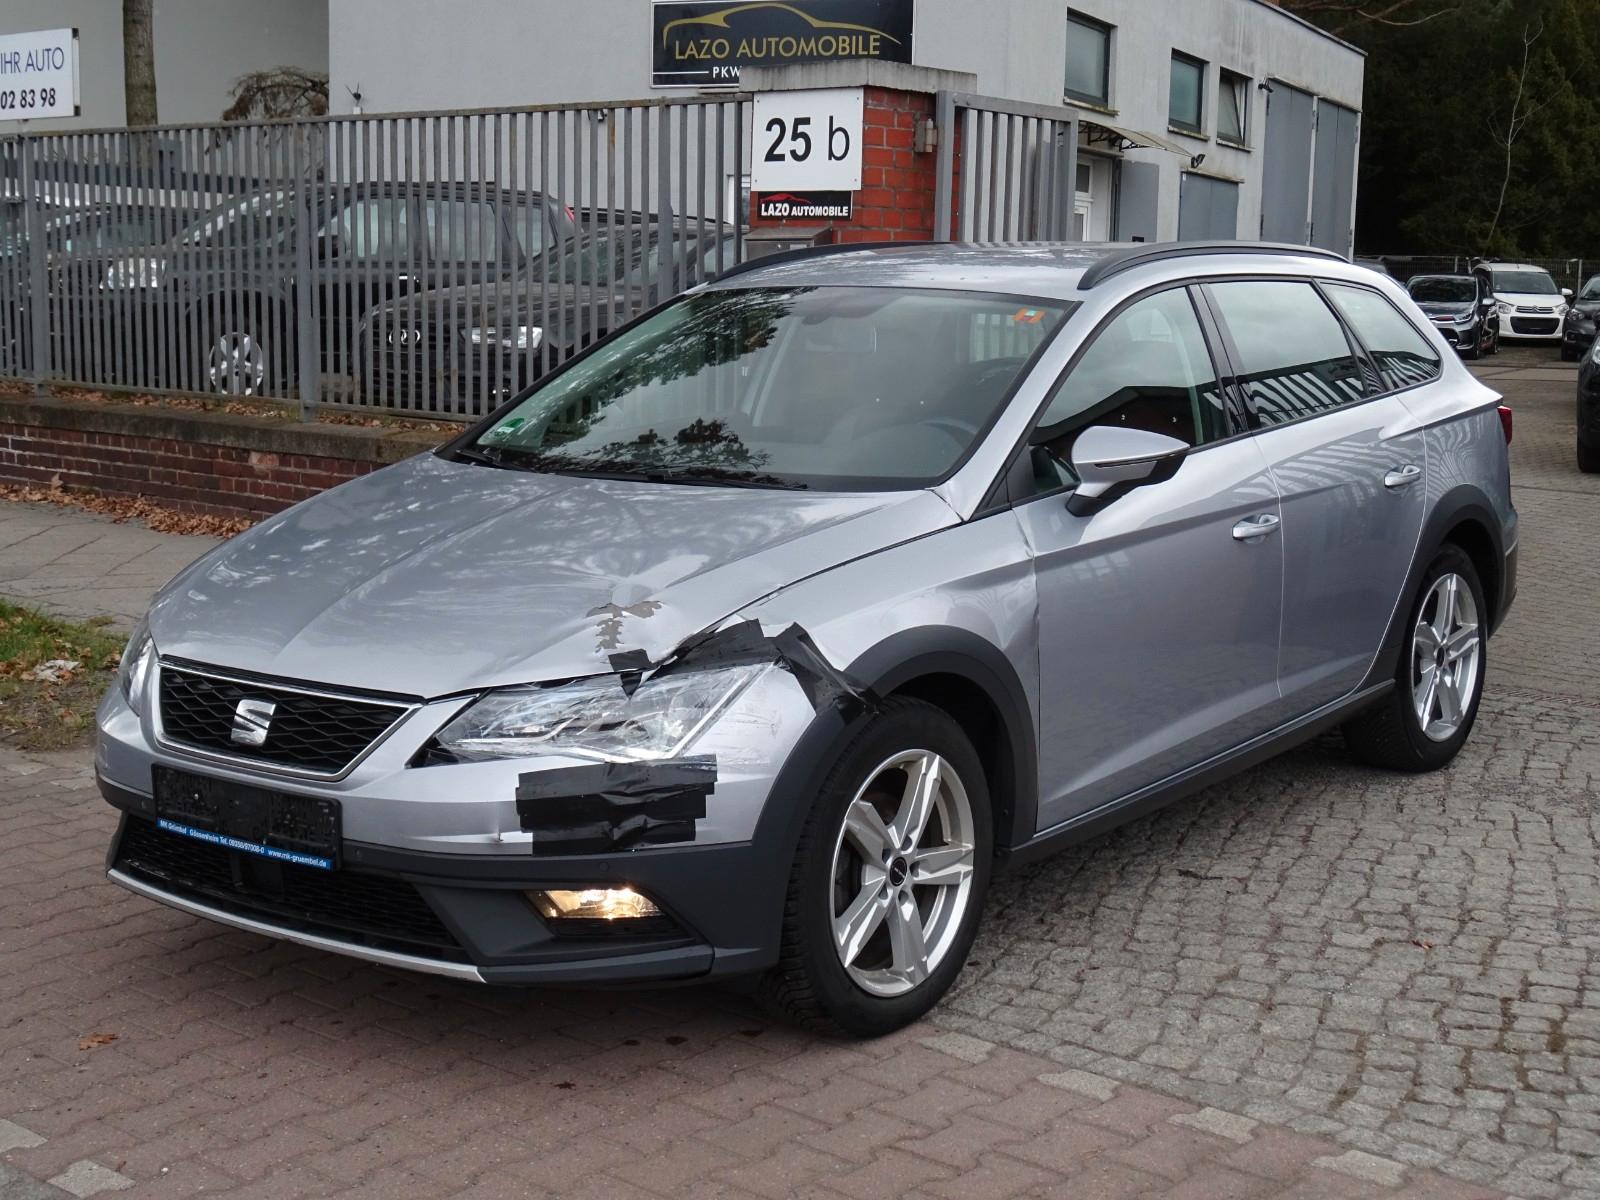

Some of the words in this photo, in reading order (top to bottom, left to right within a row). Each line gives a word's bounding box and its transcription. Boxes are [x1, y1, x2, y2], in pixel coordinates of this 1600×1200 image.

[675, 38, 730, 60] LAZO
[736, 34, 881, 58] AUTOMOBILE
[0, 52, 21, 74] IHR
[25, 46, 65, 73] AUTO
[712, 65, 743, 79] PKW
[20, 88, 36, 109] 83
[40, 87, 56, 107] 98
[764, 116, 812, 162] 25
[827, 115, 850, 161] b
[761, 203, 790, 217] LAZO
[791, 206, 849, 217] AUTOMOBILE
